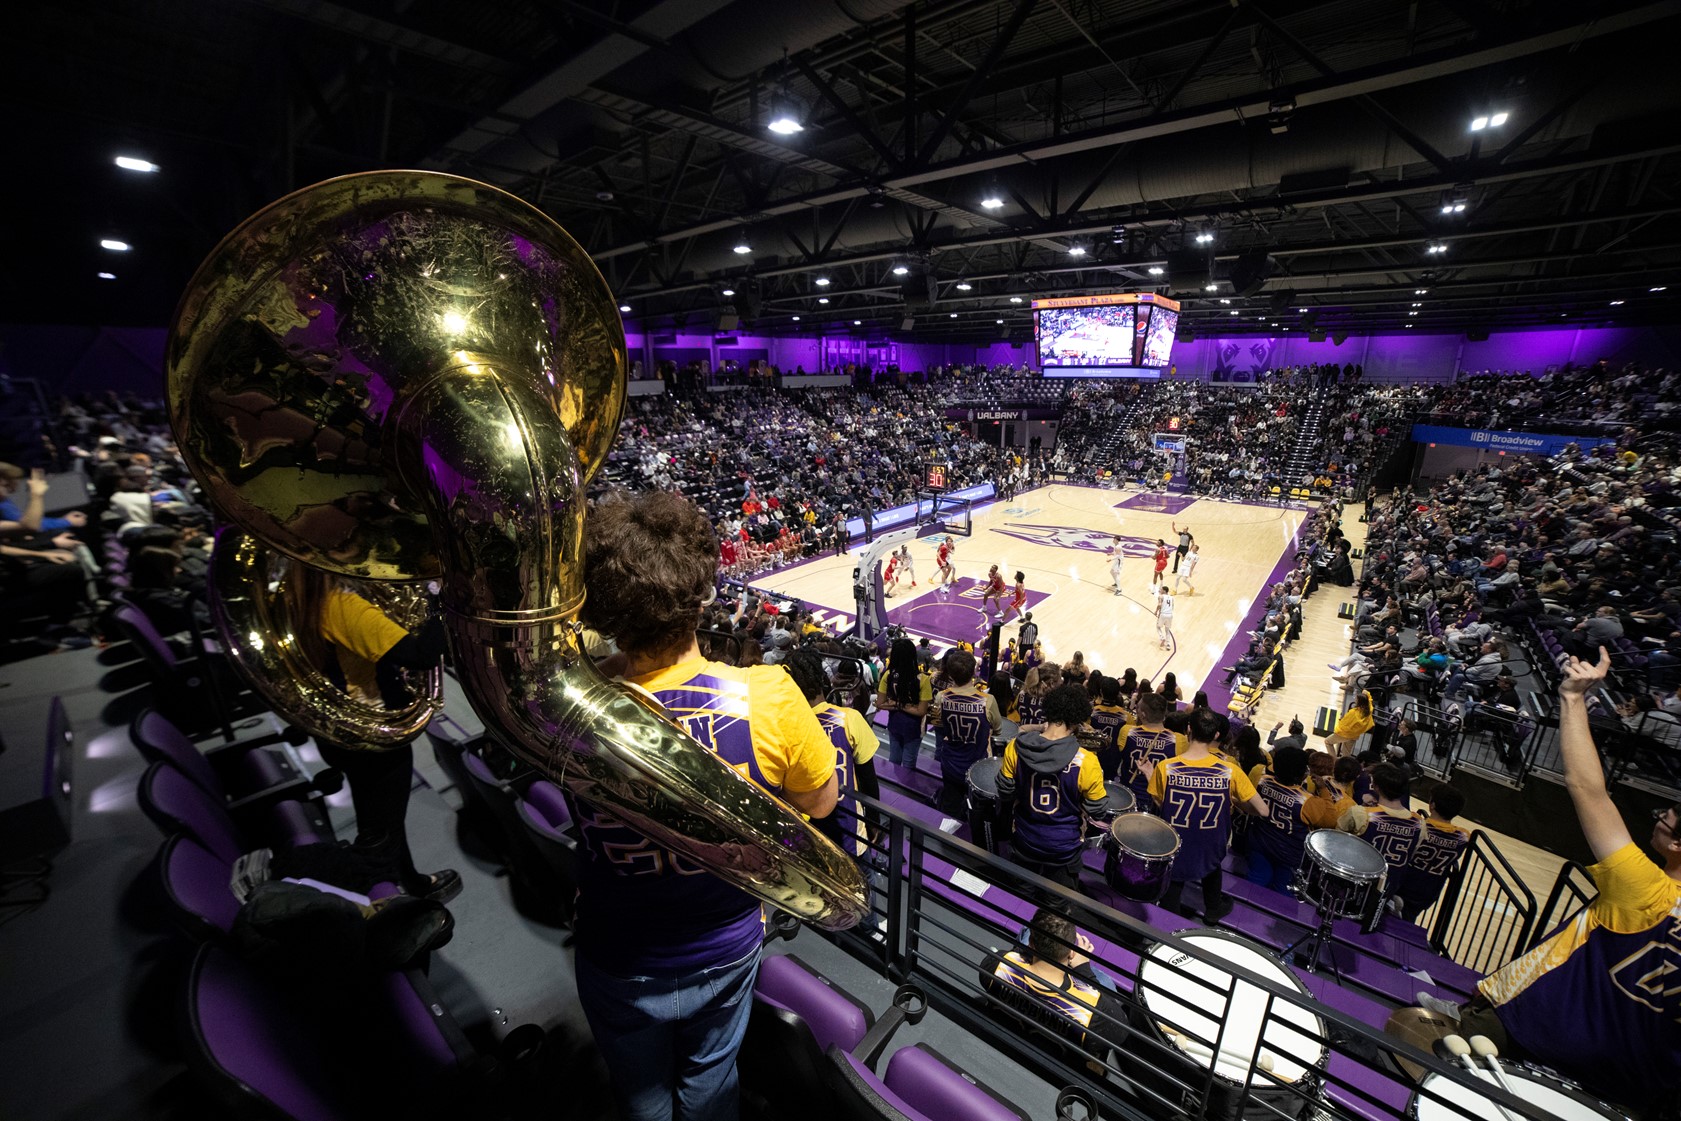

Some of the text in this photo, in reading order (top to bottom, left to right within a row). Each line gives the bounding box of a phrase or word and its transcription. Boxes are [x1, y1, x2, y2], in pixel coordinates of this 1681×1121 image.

[1091, 297, 1113, 305] PLAZA
[977, 412, 1019, 420] UALBANY
[1491, 434, 1544, 447] Broadview
[929, 473, 943, 486] 30
[943, 700, 984, 713] MANGIONE
[947, 713, 980, 744] 17
[1168, 774, 1229, 790] PEDERSEN
[1030, 771, 1060, 815] 6
[1170, 789, 1226, 829] 77
[1376, 822, 1415, 837] ELSTON
[1427, 833, 1458, 849] FOOTE
[1411, 844, 1458, 876] 27
